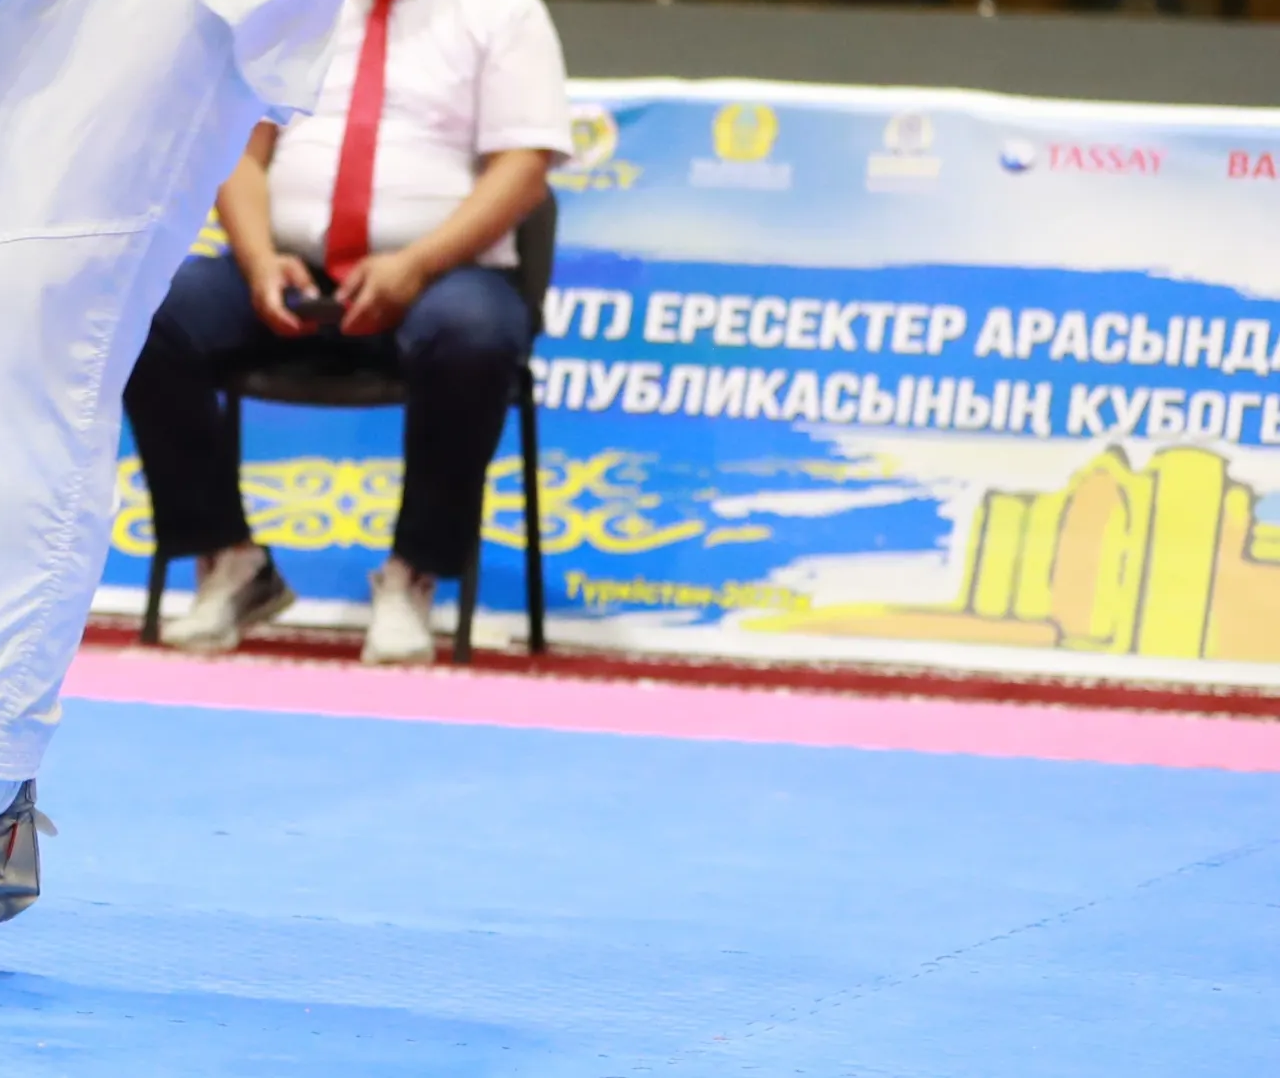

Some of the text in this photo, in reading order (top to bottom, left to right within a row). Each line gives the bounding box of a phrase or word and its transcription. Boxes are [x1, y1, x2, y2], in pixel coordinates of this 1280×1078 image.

[1048, 143, 1168, 175] TASSAY
[1227, 149, 1279, 179] BA
[643, 291, 967, 355] ЕРЕСЕКТЕР
[974, 306, 1280, 376] АРАСЫНД
